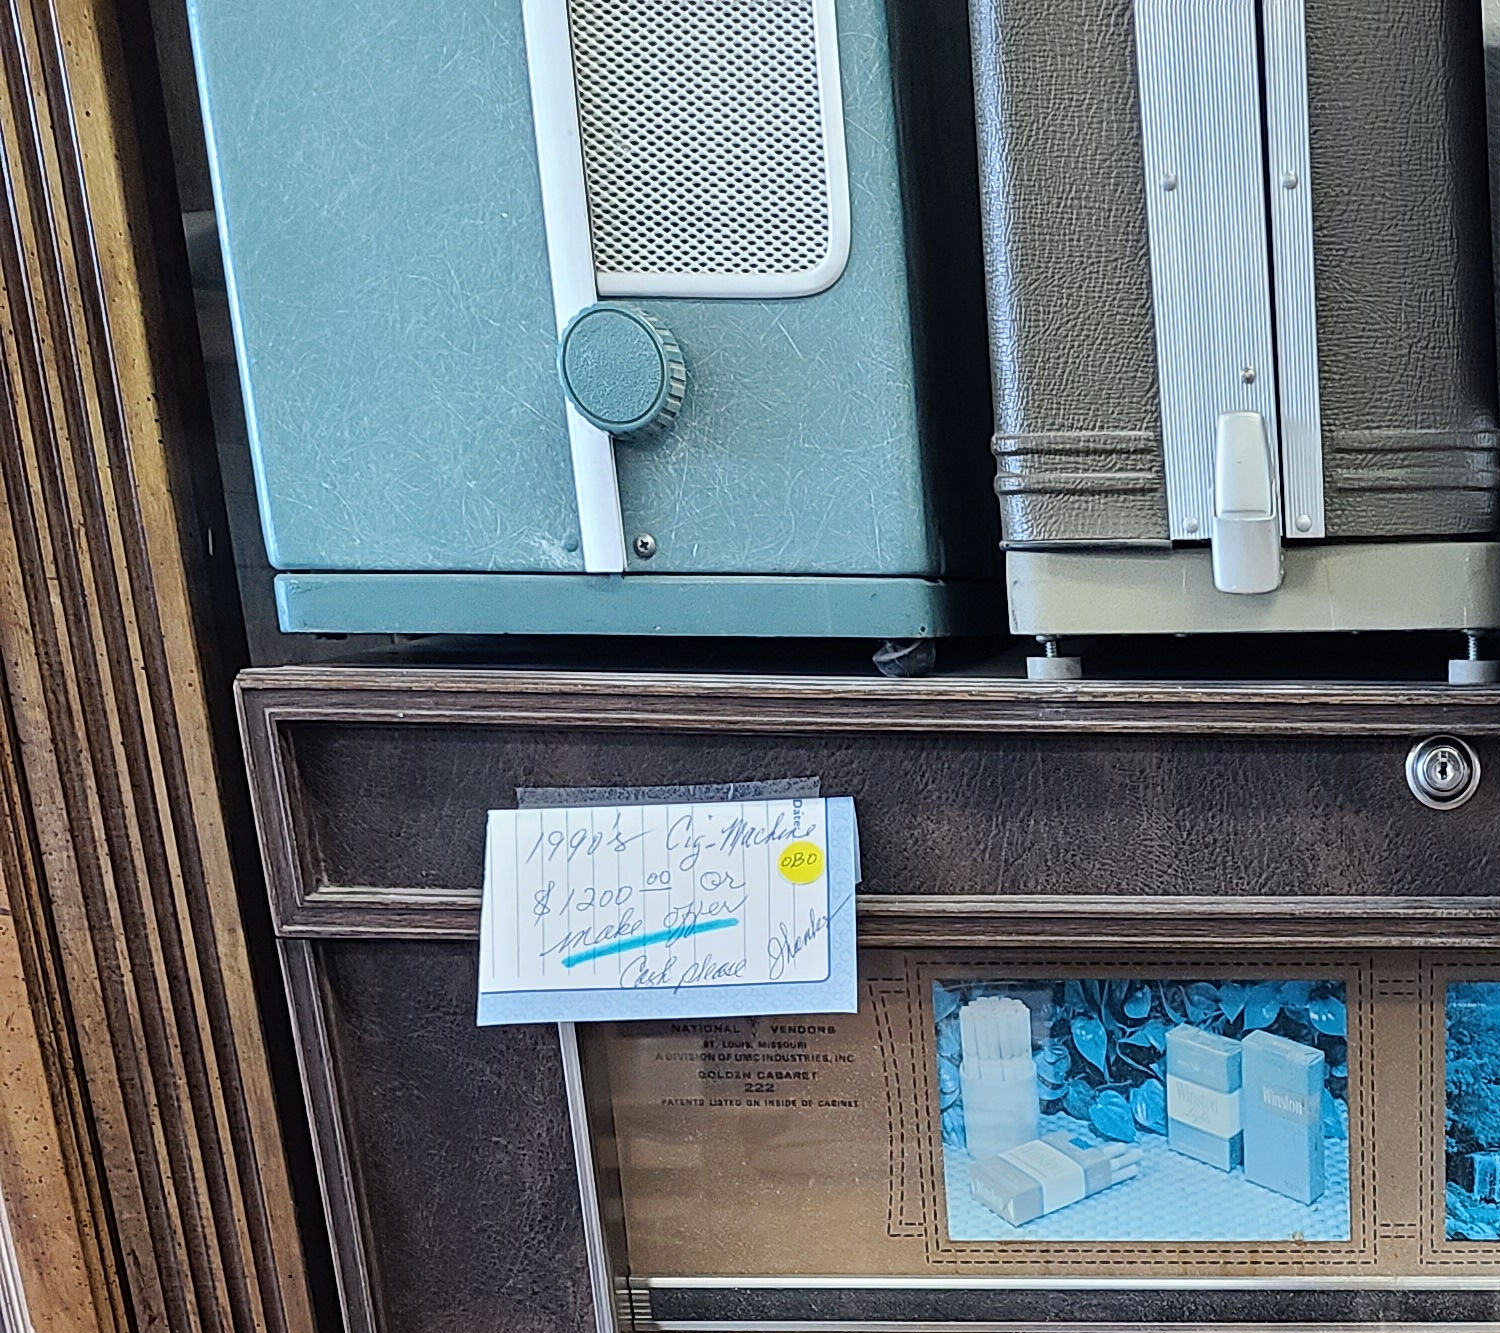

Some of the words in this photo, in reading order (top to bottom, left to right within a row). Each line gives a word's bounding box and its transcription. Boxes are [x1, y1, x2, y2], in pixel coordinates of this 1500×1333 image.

[780, 851, 818, 868] OBO
[539, 907, 644, 957] make
[619, 955, 672, 990] Cash
[673, 952, 747, 995] please
[671, 1024, 741, 1034] NATIONAL
[771, 1025, 836, 1034] VENDORS
[758, 1040, 808, 1049] MISSOURI
[757, 1071, 818, 1080] CABARET
[744, 1083, 775, 1093] 222
[1262, 1084, 1303, 1116] Winston
